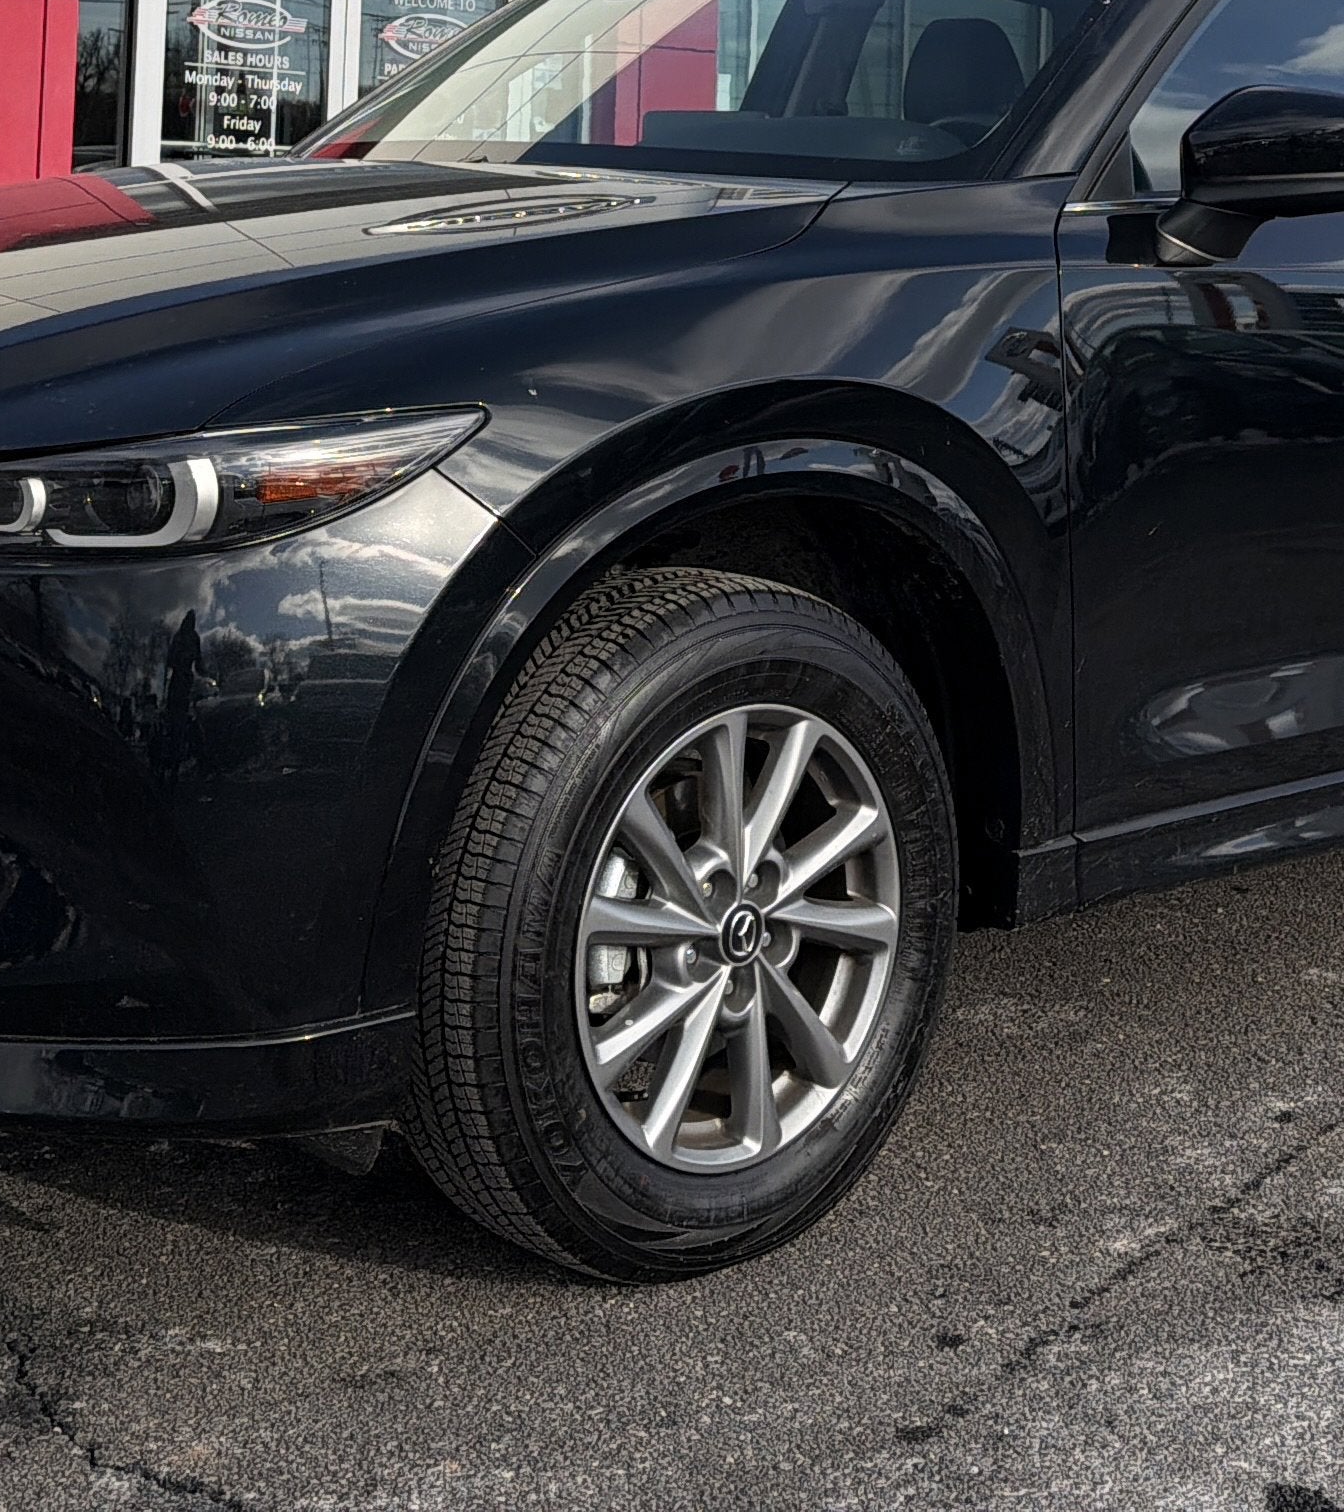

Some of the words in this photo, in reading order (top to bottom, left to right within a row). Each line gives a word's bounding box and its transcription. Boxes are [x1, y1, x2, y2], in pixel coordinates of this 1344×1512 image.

[212, 0, 289, 28] Romeo
[220, 27, 274, 41] NISSAN
[204, 48, 244, 66] SALES
[247, 52, 291, 69] HOURS
[184, 69, 235, 90] Monday
[245, 74, 303, 94] Thursday
[208, 91, 238, 107] 9:00
[249, 94, 277, 109] 7:00
[223, 114, 262, 134] Friday
[207, 133, 236, 150] 9:00
[247, 136, 275, 151] 6:00
[514, 850, 586, 1188] YOKOHAMA
